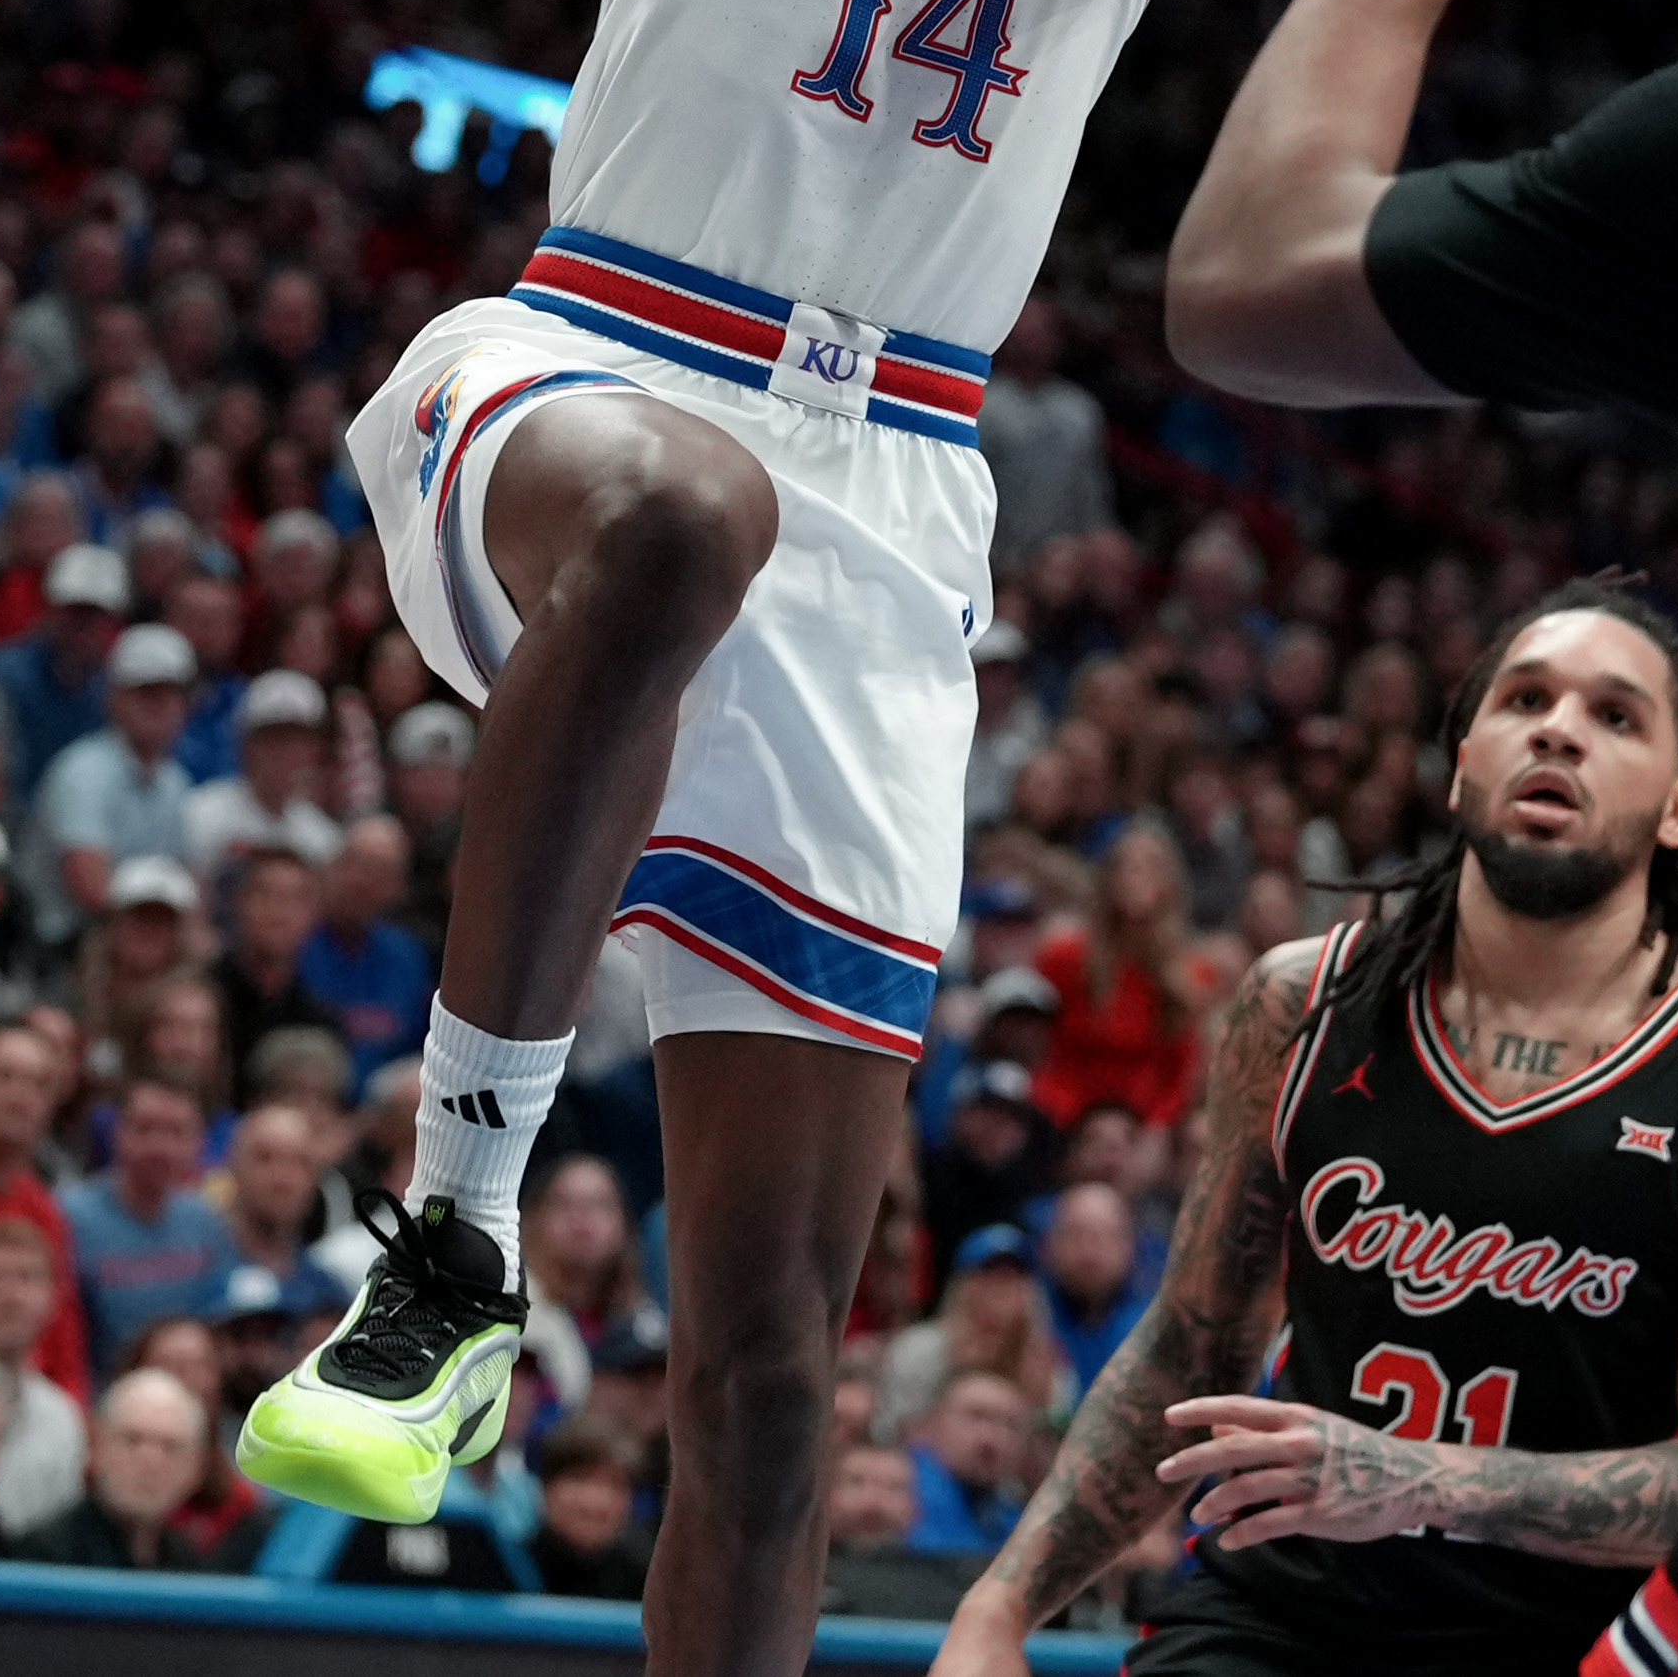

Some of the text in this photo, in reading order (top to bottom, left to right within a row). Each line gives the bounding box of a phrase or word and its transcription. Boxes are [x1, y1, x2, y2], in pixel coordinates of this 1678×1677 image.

[798, 336, 861, 385] KU
[1492, 1031, 1568, 1077] THE
[1300, 1155, 1638, 1319] Cougars
[1350, 1341, 1520, 1447] 21
